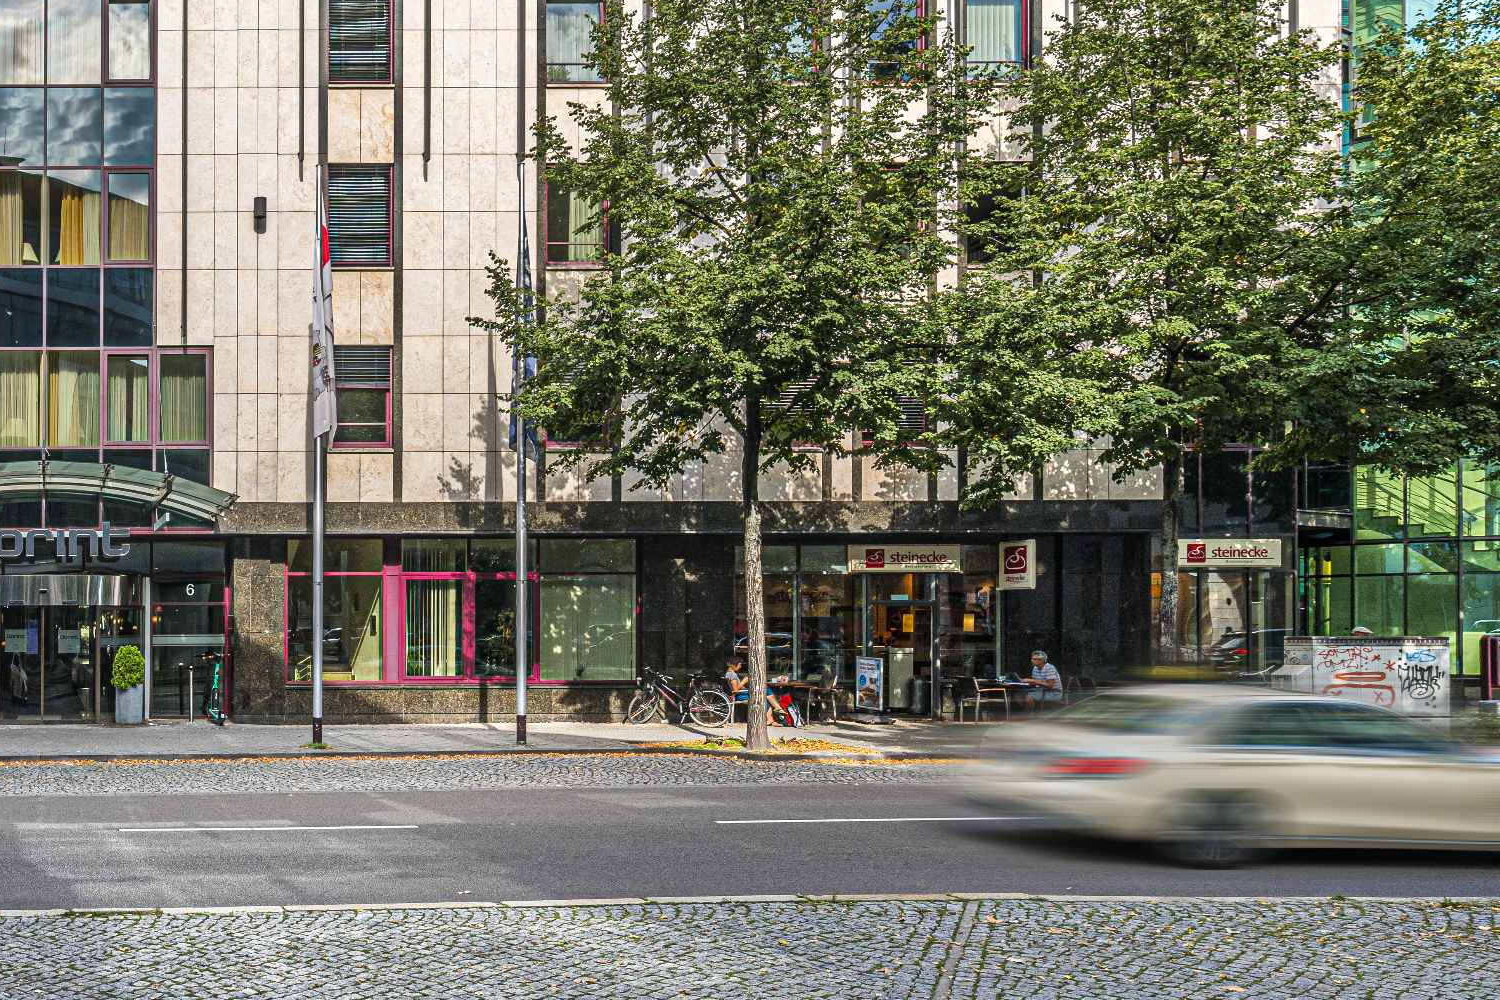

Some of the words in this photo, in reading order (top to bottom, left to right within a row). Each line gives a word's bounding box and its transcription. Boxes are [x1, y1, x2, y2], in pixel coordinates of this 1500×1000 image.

[890, 551, 947, 563] steinecke
[1211, 546, 1269, 558] steinecke
[185, 583, 195, 596] 6
